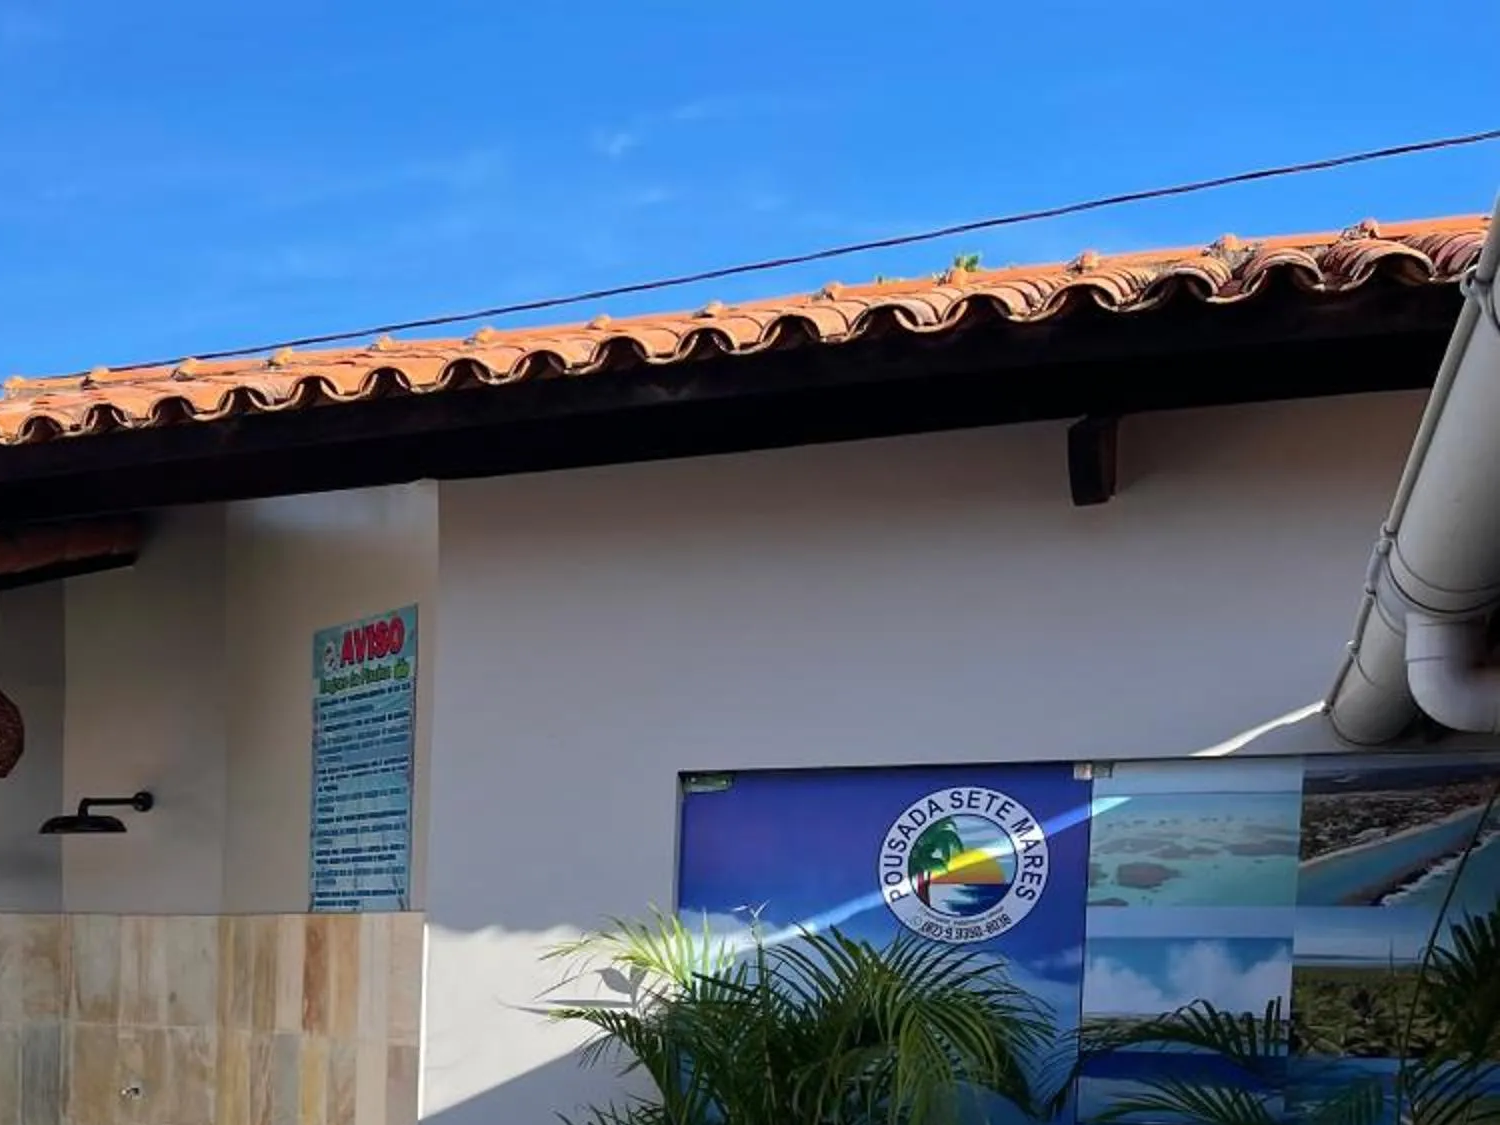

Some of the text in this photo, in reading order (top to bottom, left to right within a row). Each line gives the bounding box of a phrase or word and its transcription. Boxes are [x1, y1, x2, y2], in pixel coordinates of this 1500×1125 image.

[339, 615, 405, 668] AVISO
[884, 790, 1043, 903] POUSADA SETE MARES
